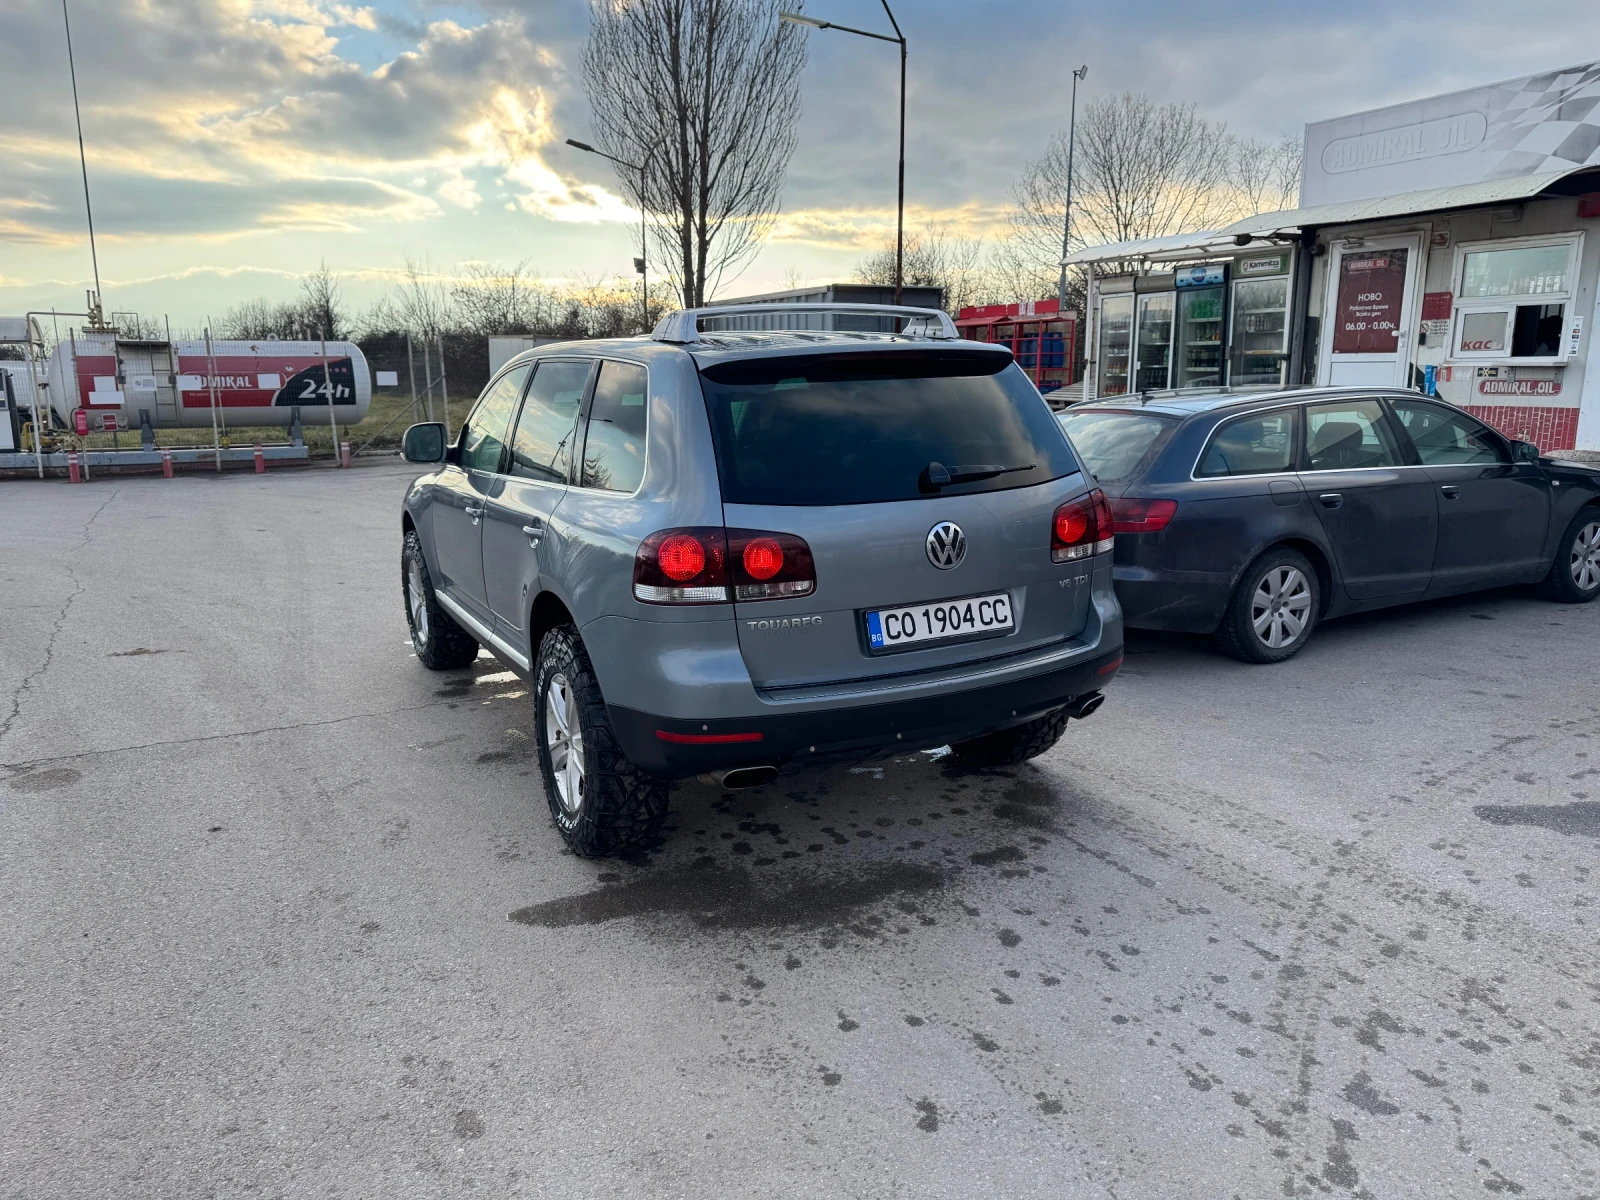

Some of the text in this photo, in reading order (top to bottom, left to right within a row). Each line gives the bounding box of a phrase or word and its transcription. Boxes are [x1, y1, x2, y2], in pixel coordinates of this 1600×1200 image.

[1334, 130, 1427, 169] ADMIRAL
[1249, 259, 1280, 269] Kamenitza
[1358, 292, 1382, 302] НОВО
[1345, 322, 1366, 331] 06.00
[200, 375, 253, 390] DMIRAL
[298, 379, 350, 398] 24h
[1484, 381, 1556, 395] ADMIRAL OIL
[1059, 574, 1088, 588] V6 TDI
[747, 616, 823, 631] TOUAREG
[871, 598, 1008, 642] BG CO 1904 CC
